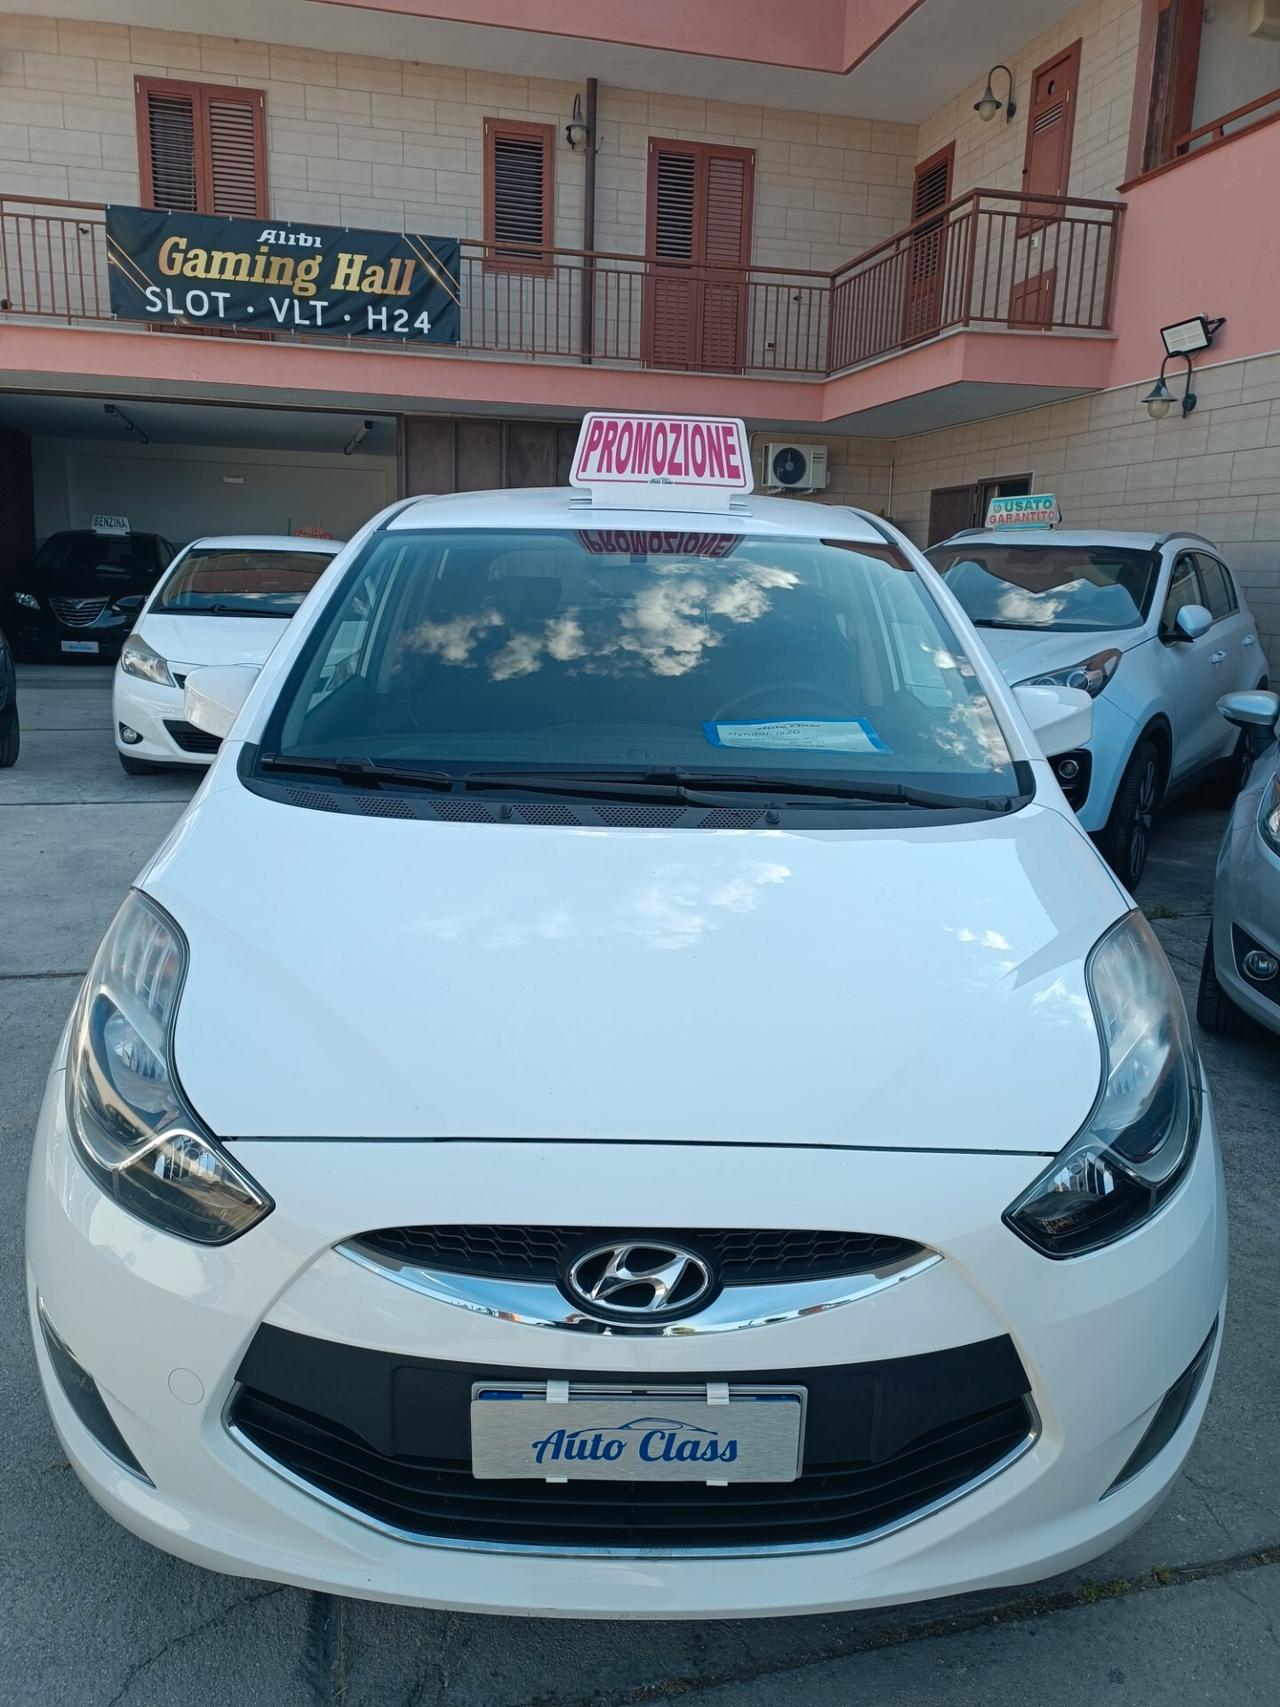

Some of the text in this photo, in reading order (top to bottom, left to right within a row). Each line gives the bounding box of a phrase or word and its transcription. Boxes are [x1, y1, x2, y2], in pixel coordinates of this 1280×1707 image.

[158, 236, 416, 296] Gaming Hall
[145, 286, 431, 334] SLOT VLT H24
[581, 420, 741, 479] PROMOZIONE
[93, 516, 128, 528] BENZINA
[990, 510, 1056, 524] GARANTITO
[1004, 499, 1053, 512] USATO
[532, 1429, 738, 1464] Auto Class
